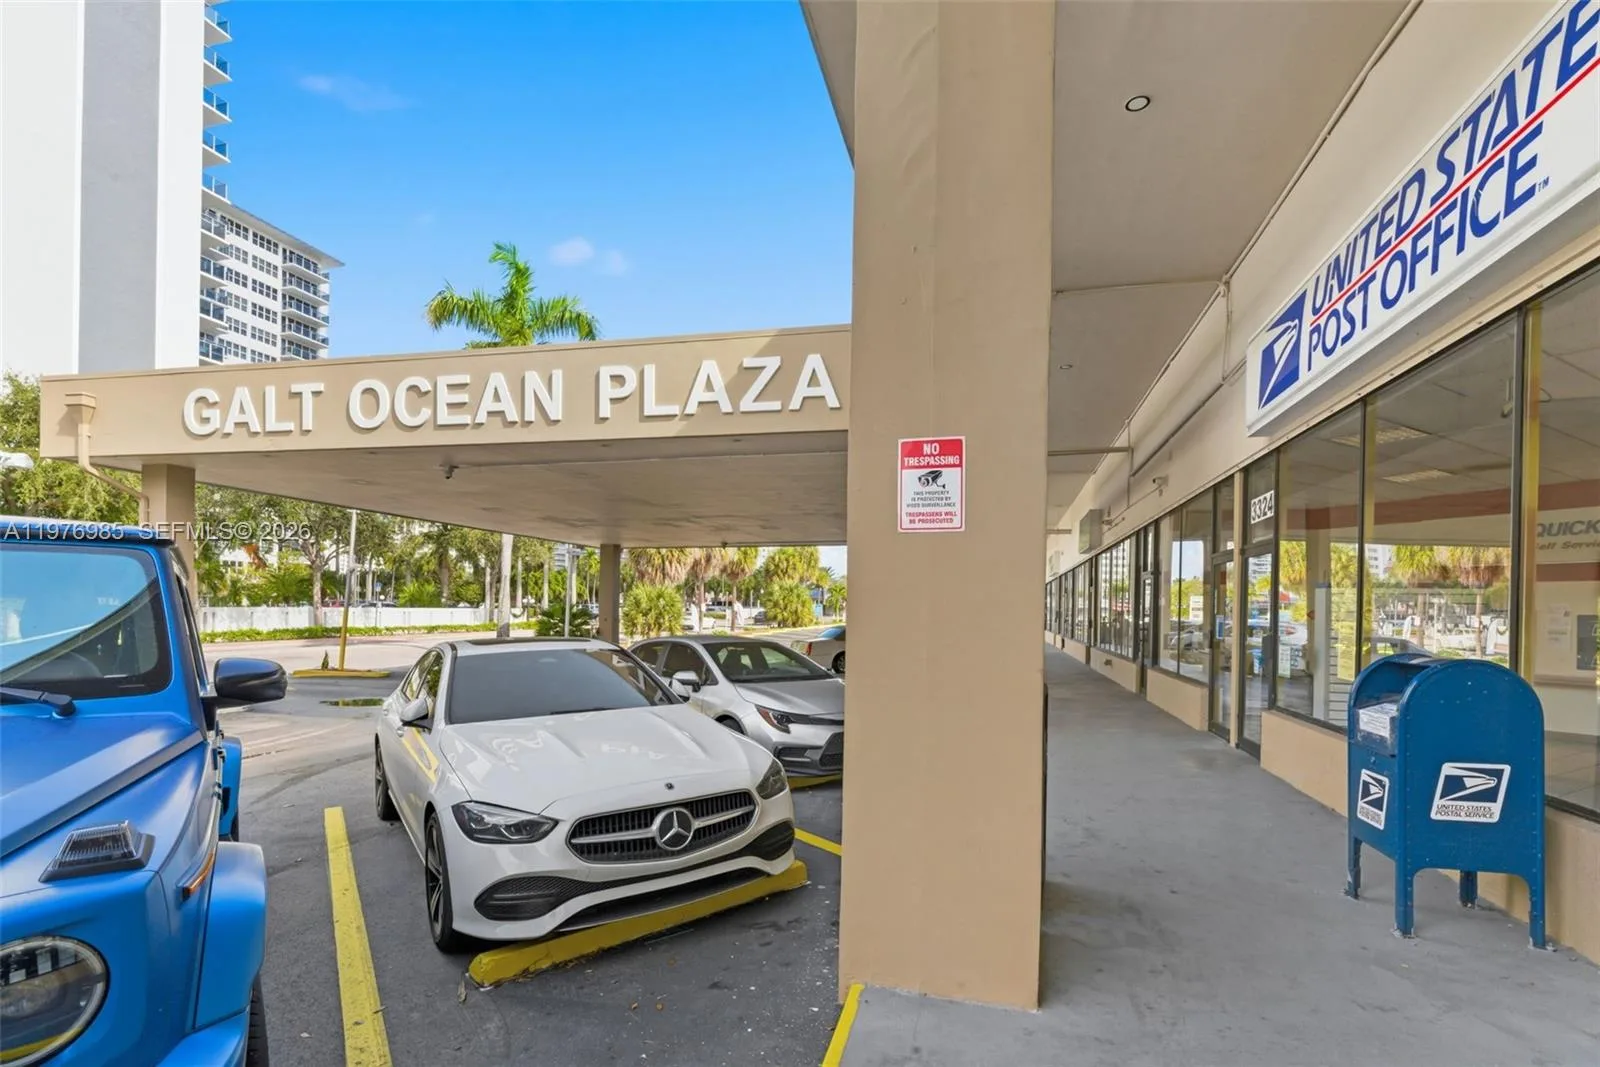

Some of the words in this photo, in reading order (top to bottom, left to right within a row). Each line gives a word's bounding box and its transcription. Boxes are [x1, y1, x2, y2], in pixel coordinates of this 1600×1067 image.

[1308, 272, 1376, 372] POST
[1380, 121, 1544, 310] OFFICE
[1311, 168, 1425, 317] UNITED
[183, 382, 324, 436] GALT
[347, 368, 562, 429] OCEAN
[598, 353, 841, 420] PLAZA
[923, 442, 940, 455] NO
[903, 455, 960, 467] TRESPASSING
[1251, 492, 1273, 521] 3324
[1435, 810, 1462, 818] POSTAL
[1464, 811, 1495, 819] SERVICE
[1436, 804, 1466, 812] UNITED
